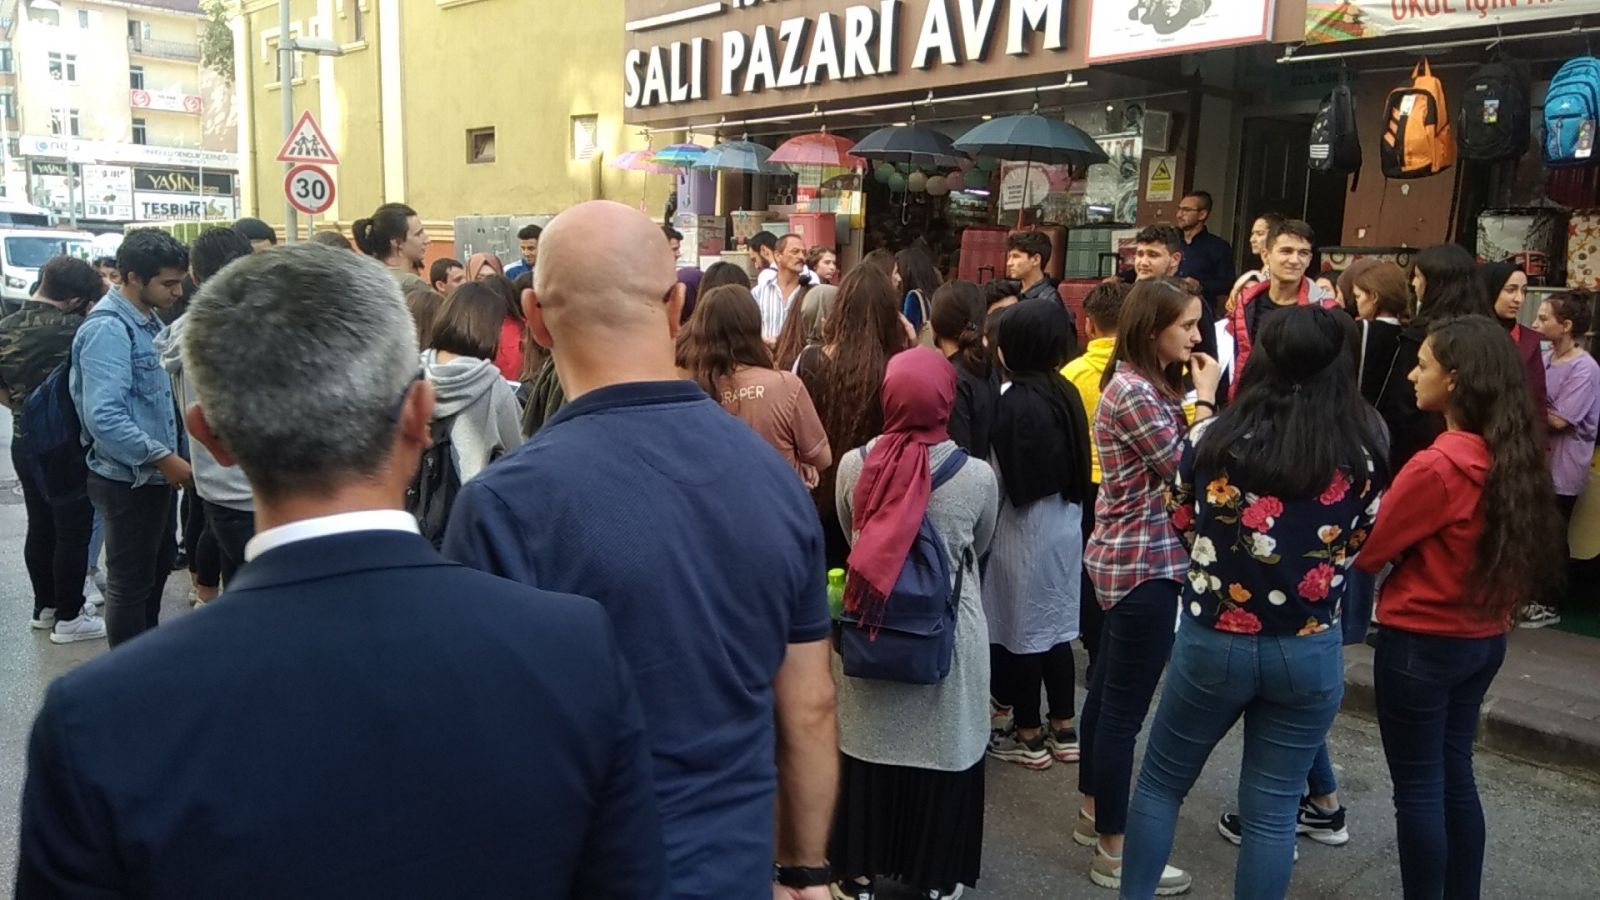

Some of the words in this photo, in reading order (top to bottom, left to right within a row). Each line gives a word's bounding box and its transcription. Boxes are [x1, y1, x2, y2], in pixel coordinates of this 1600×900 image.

[624, 37, 703, 108] SALI
[911, 0, 1062, 68] AVM
[296, 178, 325, 200] 30
